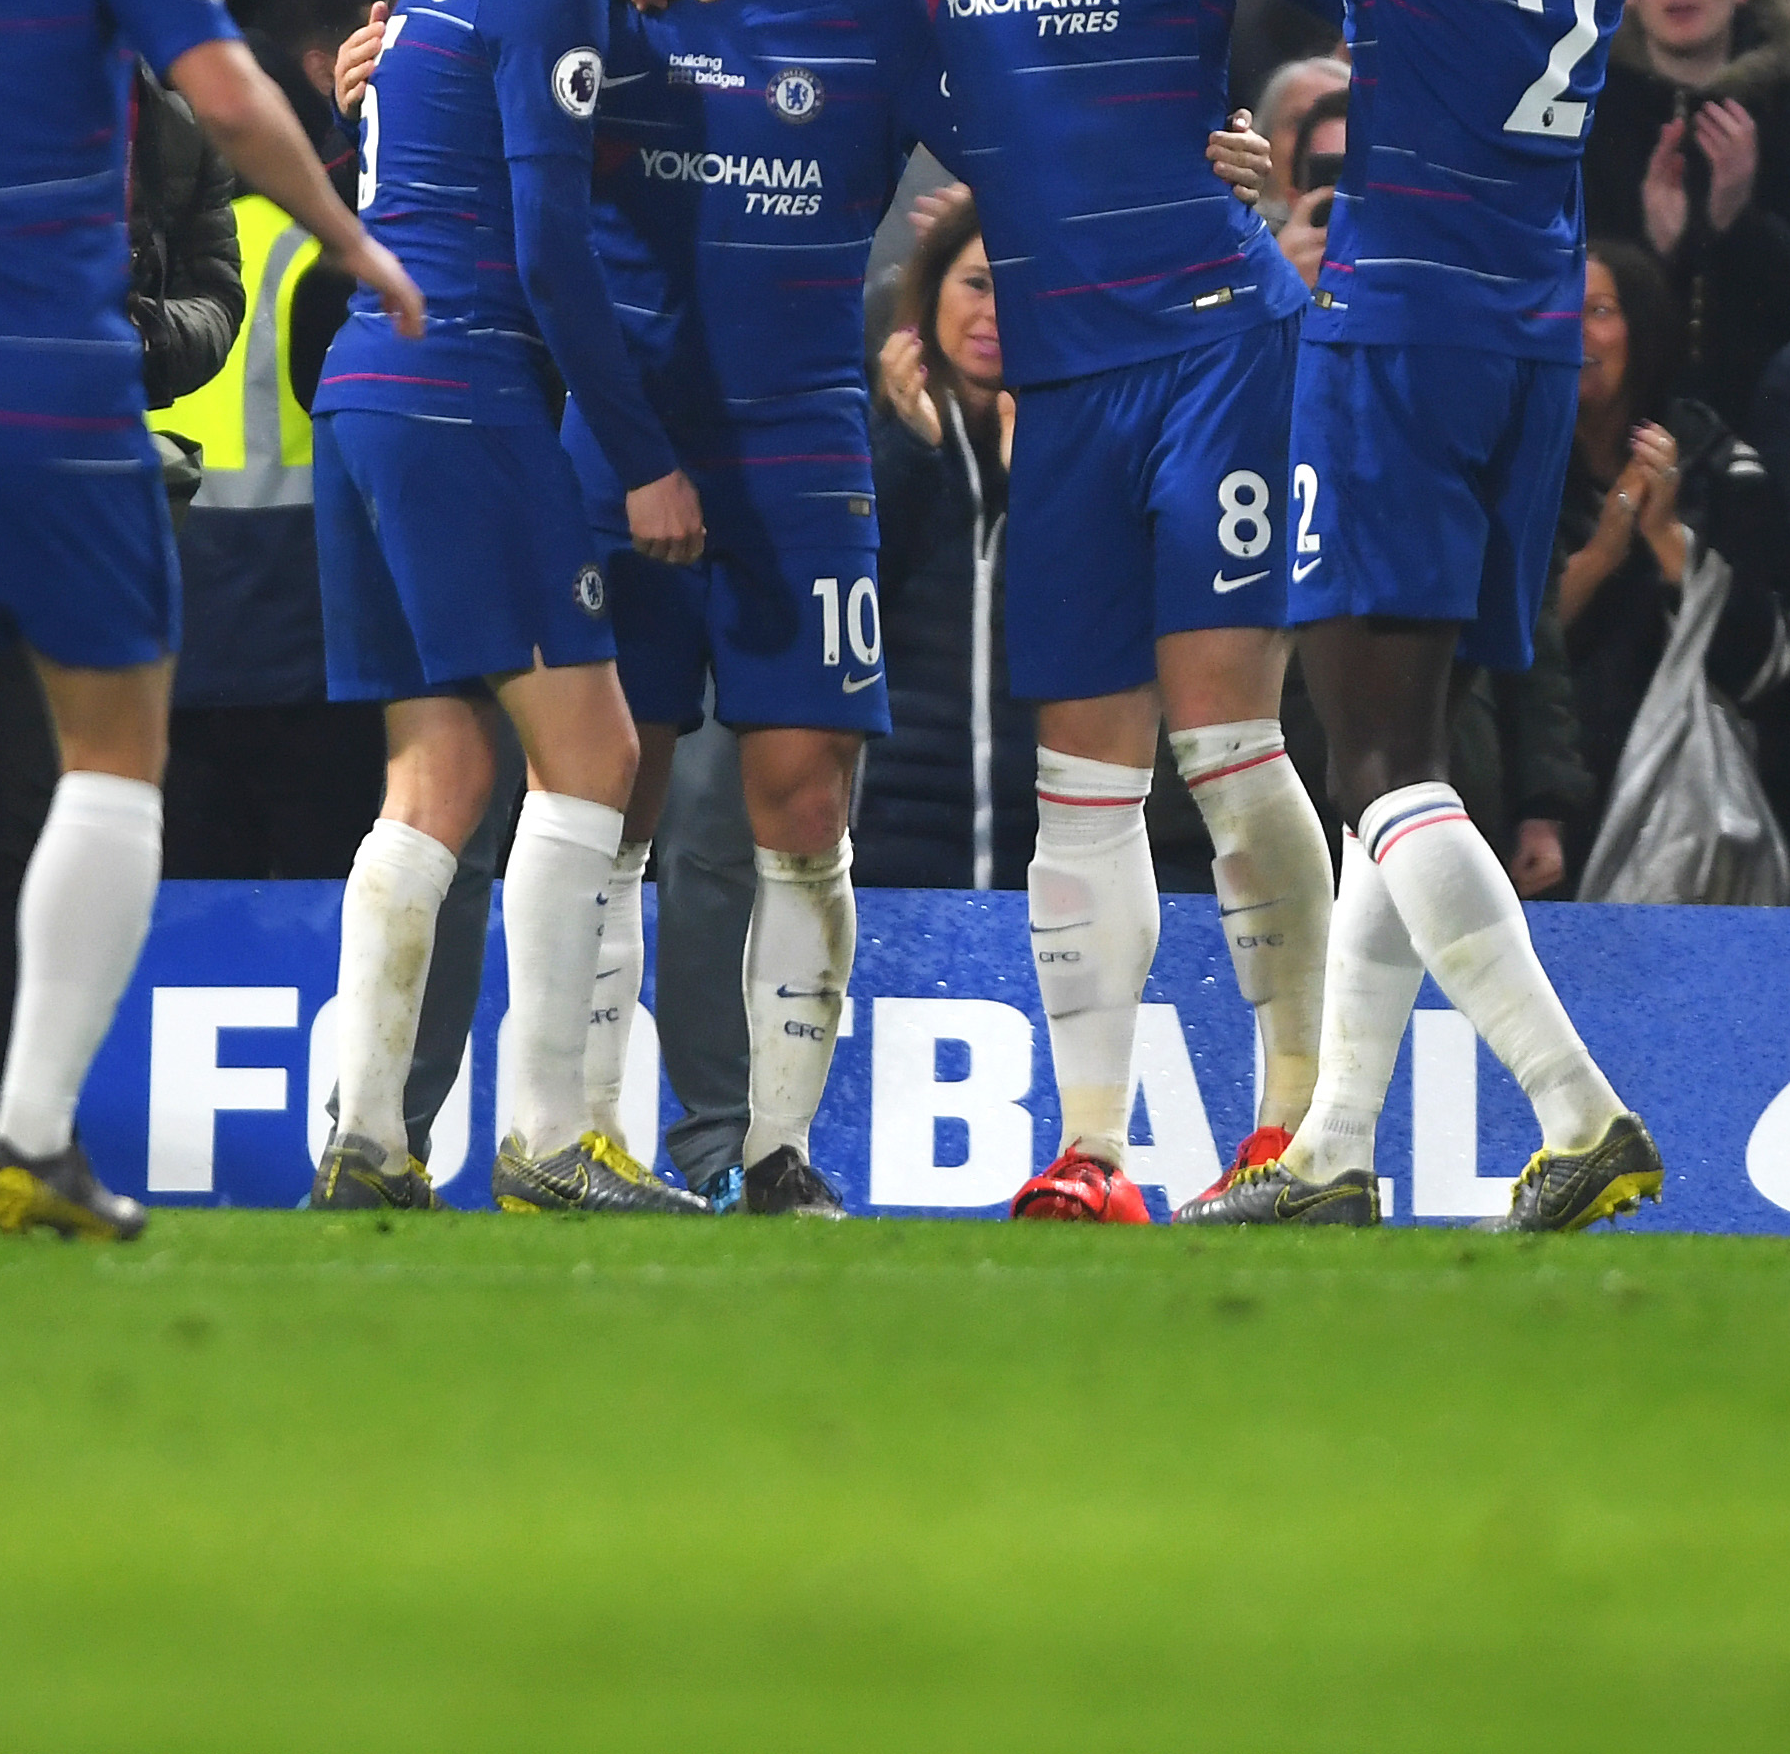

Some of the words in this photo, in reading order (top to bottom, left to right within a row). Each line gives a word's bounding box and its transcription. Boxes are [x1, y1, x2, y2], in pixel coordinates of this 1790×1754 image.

[1036, 9, 1120, 37] TYRES
[669, 53, 723, 72] building
[695, 69, 745, 89] bridges
[641, 148, 823, 189] YOKOHAMA
[745, 193, 822, 215] TYRES
[1218, 469, 1271, 558] 8
[1294, 463, 1320, 553] 2
[812, 576, 881, 666] 10
[1236, 933, 1285, 949] CFC
[1039, 951, 1081, 963] CFC
[783, 1019, 826, 1042] CFC
